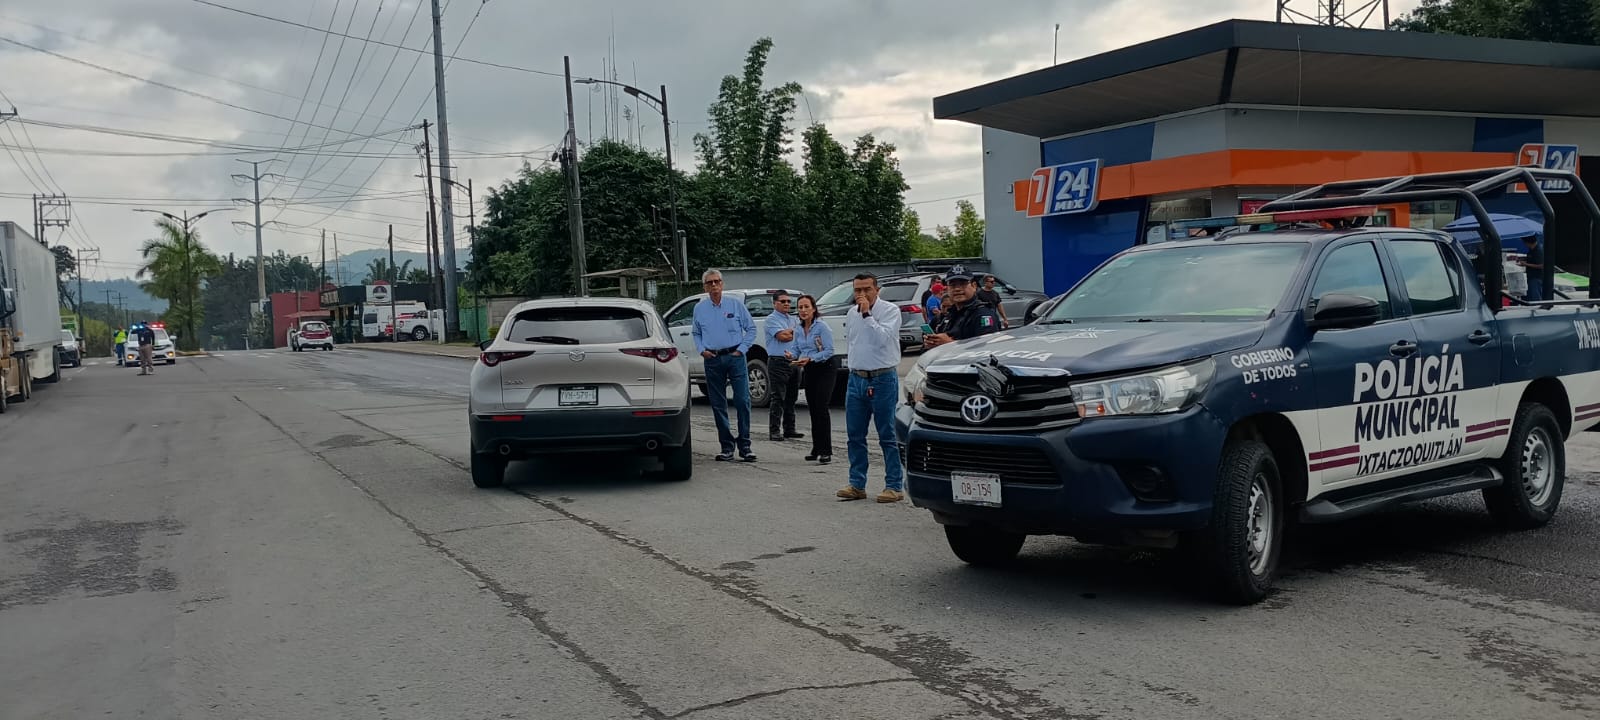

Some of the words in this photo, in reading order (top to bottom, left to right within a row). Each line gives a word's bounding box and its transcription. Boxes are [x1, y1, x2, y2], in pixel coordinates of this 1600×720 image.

[1055, 167, 1090, 200] 24
[1054, 198, 1085, 211] MIX
[1230, 346, 1294, 369] GOBIERNO
[1353, 344, 1464, 402] POLICÍA
[1242, 369, 1260, 385] DE
[1260, 364, 1297, 381] TODOS
[1354, 394, 1460, 443] MUNICIPAL
[1356, 433, 1463, 476] IXTACZOQUITLÁN
